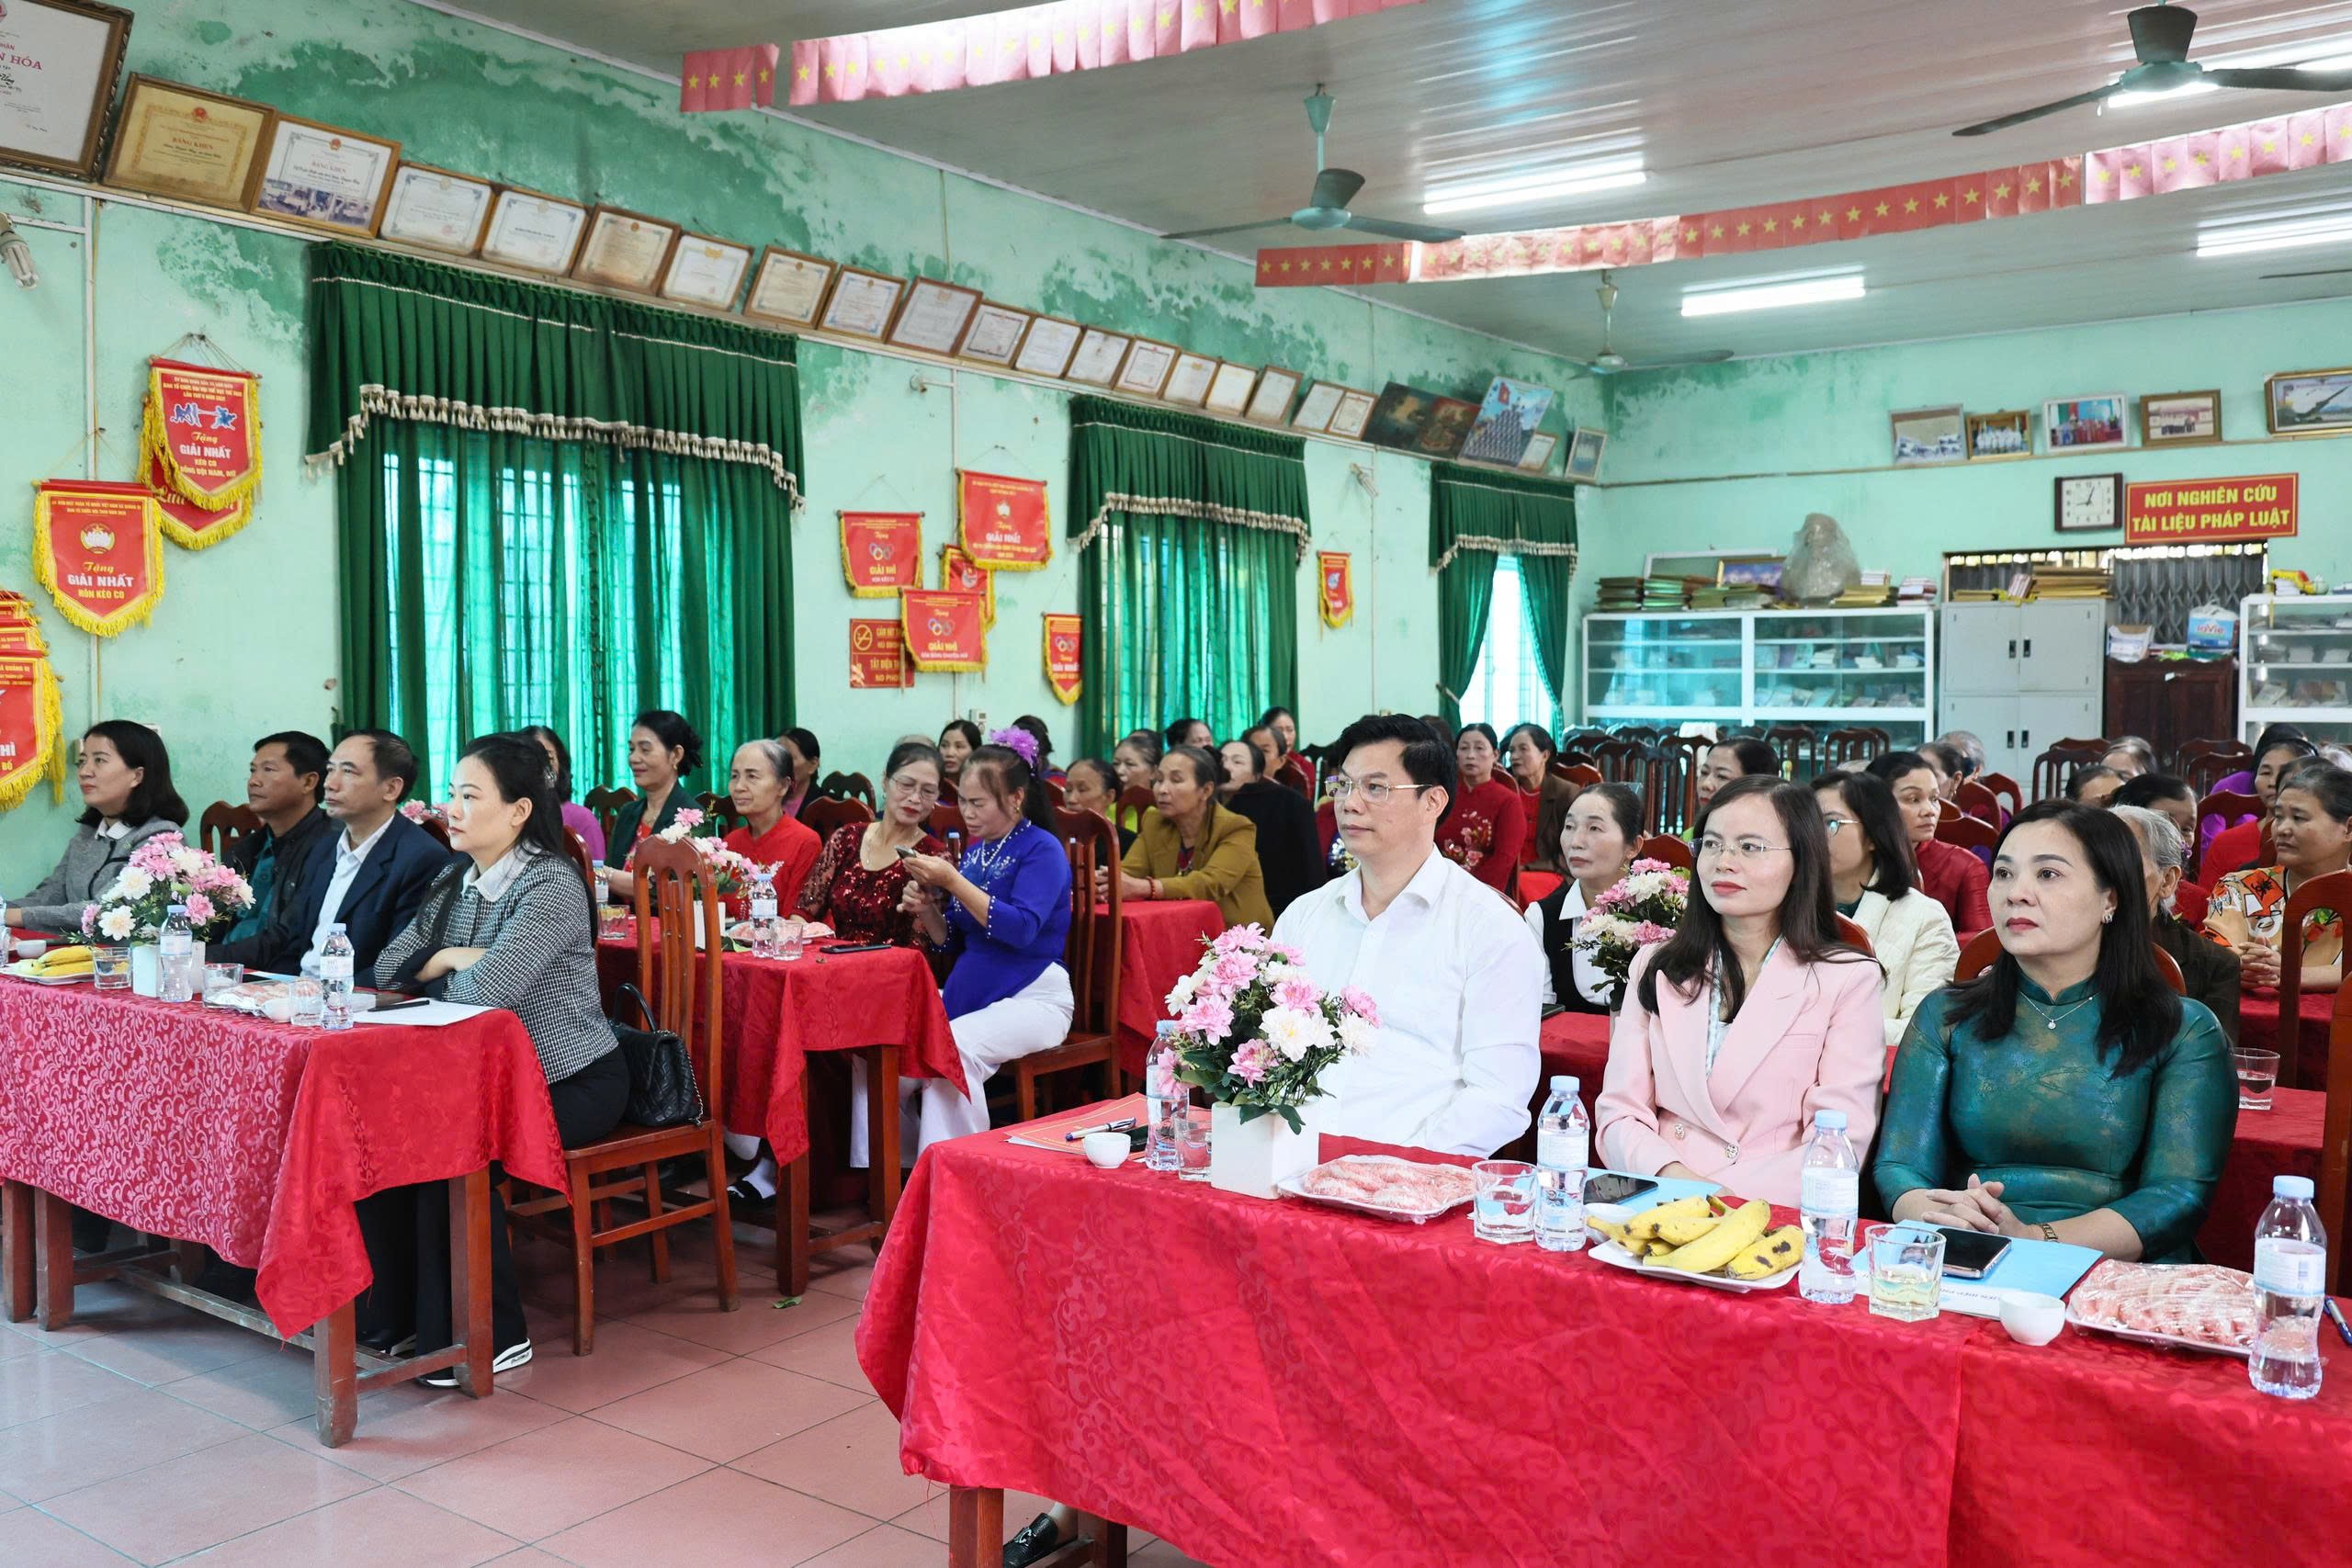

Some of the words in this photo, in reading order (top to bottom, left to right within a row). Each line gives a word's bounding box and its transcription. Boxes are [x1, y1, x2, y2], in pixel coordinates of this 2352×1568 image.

[10, 56, 42, 70] HÓA
[191, 431, 218, 444] Tặng
[179, 443, 200, 456] GIẢI
[204, 446, 232, 459] NHẤT
[2144, 491, 2172, 508] NƠI
[2177, 486, 2238, 506] NGHIÊN
[2243, 483, 2278, 502] CỨU
[2132, 514, 2156, 533] TÀI
[2161, 512, 2196, 534] LIỆU
[2199, 509, 2245, 529] PHÁP
[2248, 507, 2290, 528] LUẬT
[986, 530, 1002, 542] GIẢI
[82, 561, 114, 574] Tặng
[869, 563, 885, 575] GIẢI
[67, 571, 93, 586] GIẢI
[97, 573, 134, 588] NHẤT
[96, 588, 111, 598] KÉO
[113, 591, 125, 599] CO
[927, 640, 944, 651] GIẢI
